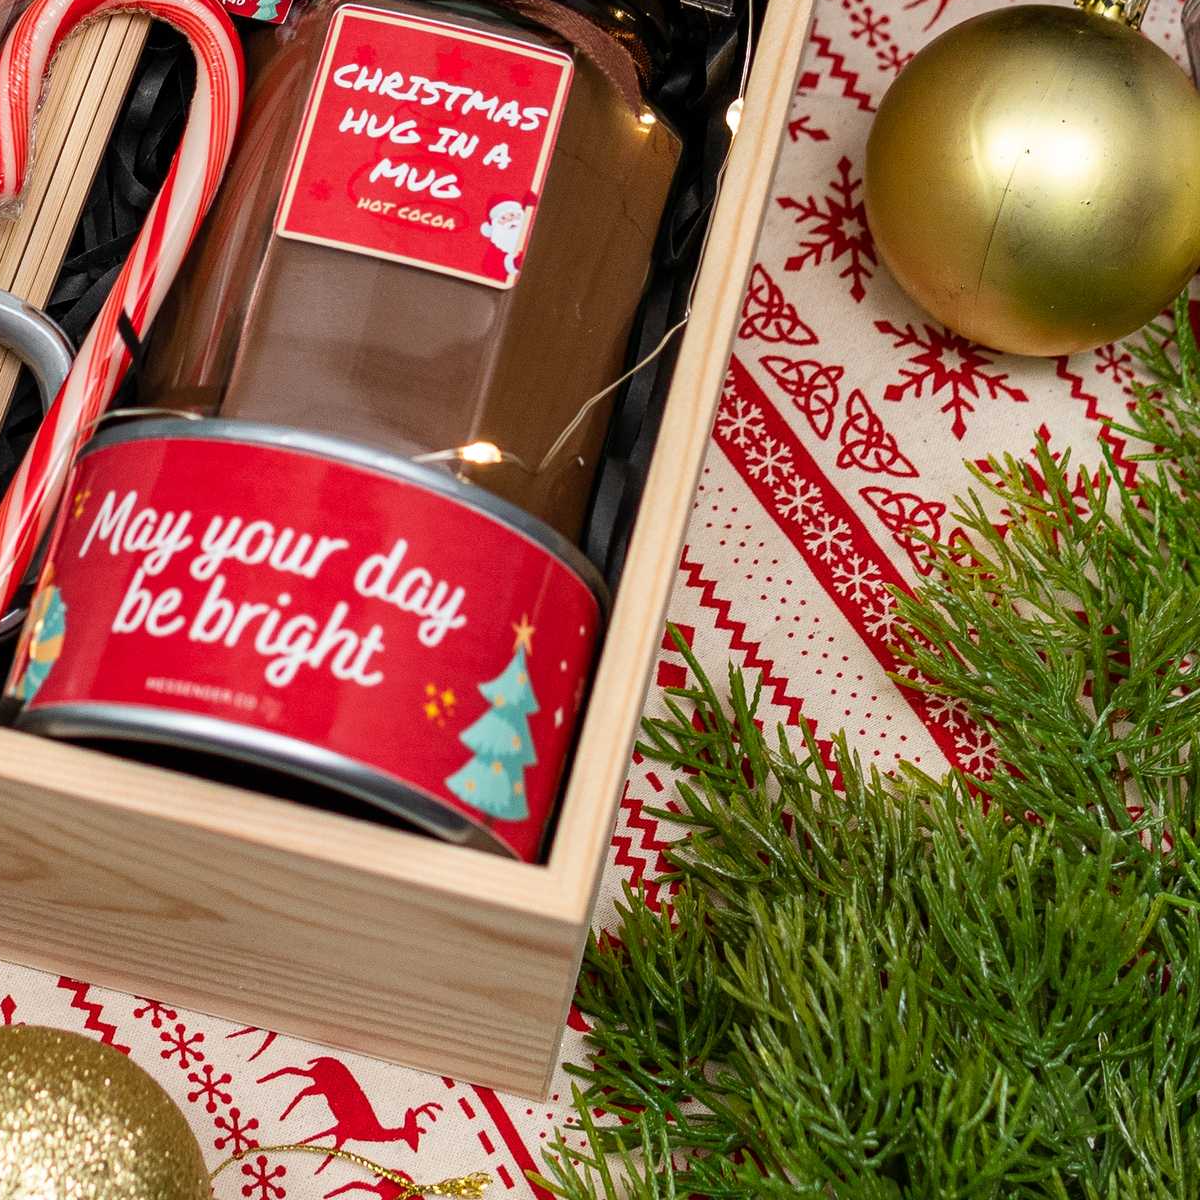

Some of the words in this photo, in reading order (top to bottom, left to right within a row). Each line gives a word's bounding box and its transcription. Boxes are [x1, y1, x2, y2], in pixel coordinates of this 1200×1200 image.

[333, 63, 549, 131] CHRISTMAS
[338, 107, 422, 144] HUG
[428, 126, 480, 159] IN
[482, 142, 512, 171] A
[369, 158, 462, 199] MUG
[356, 197, 396, 215] HOT
[397, 206, 456, 230] COCOA
[79, 490, 194, 575] May
[191, 511, 349, 580] your
[354, 538, 467, 647] day
[112, 568, 187, 636] be
[188, 575, 385, 688] bright
